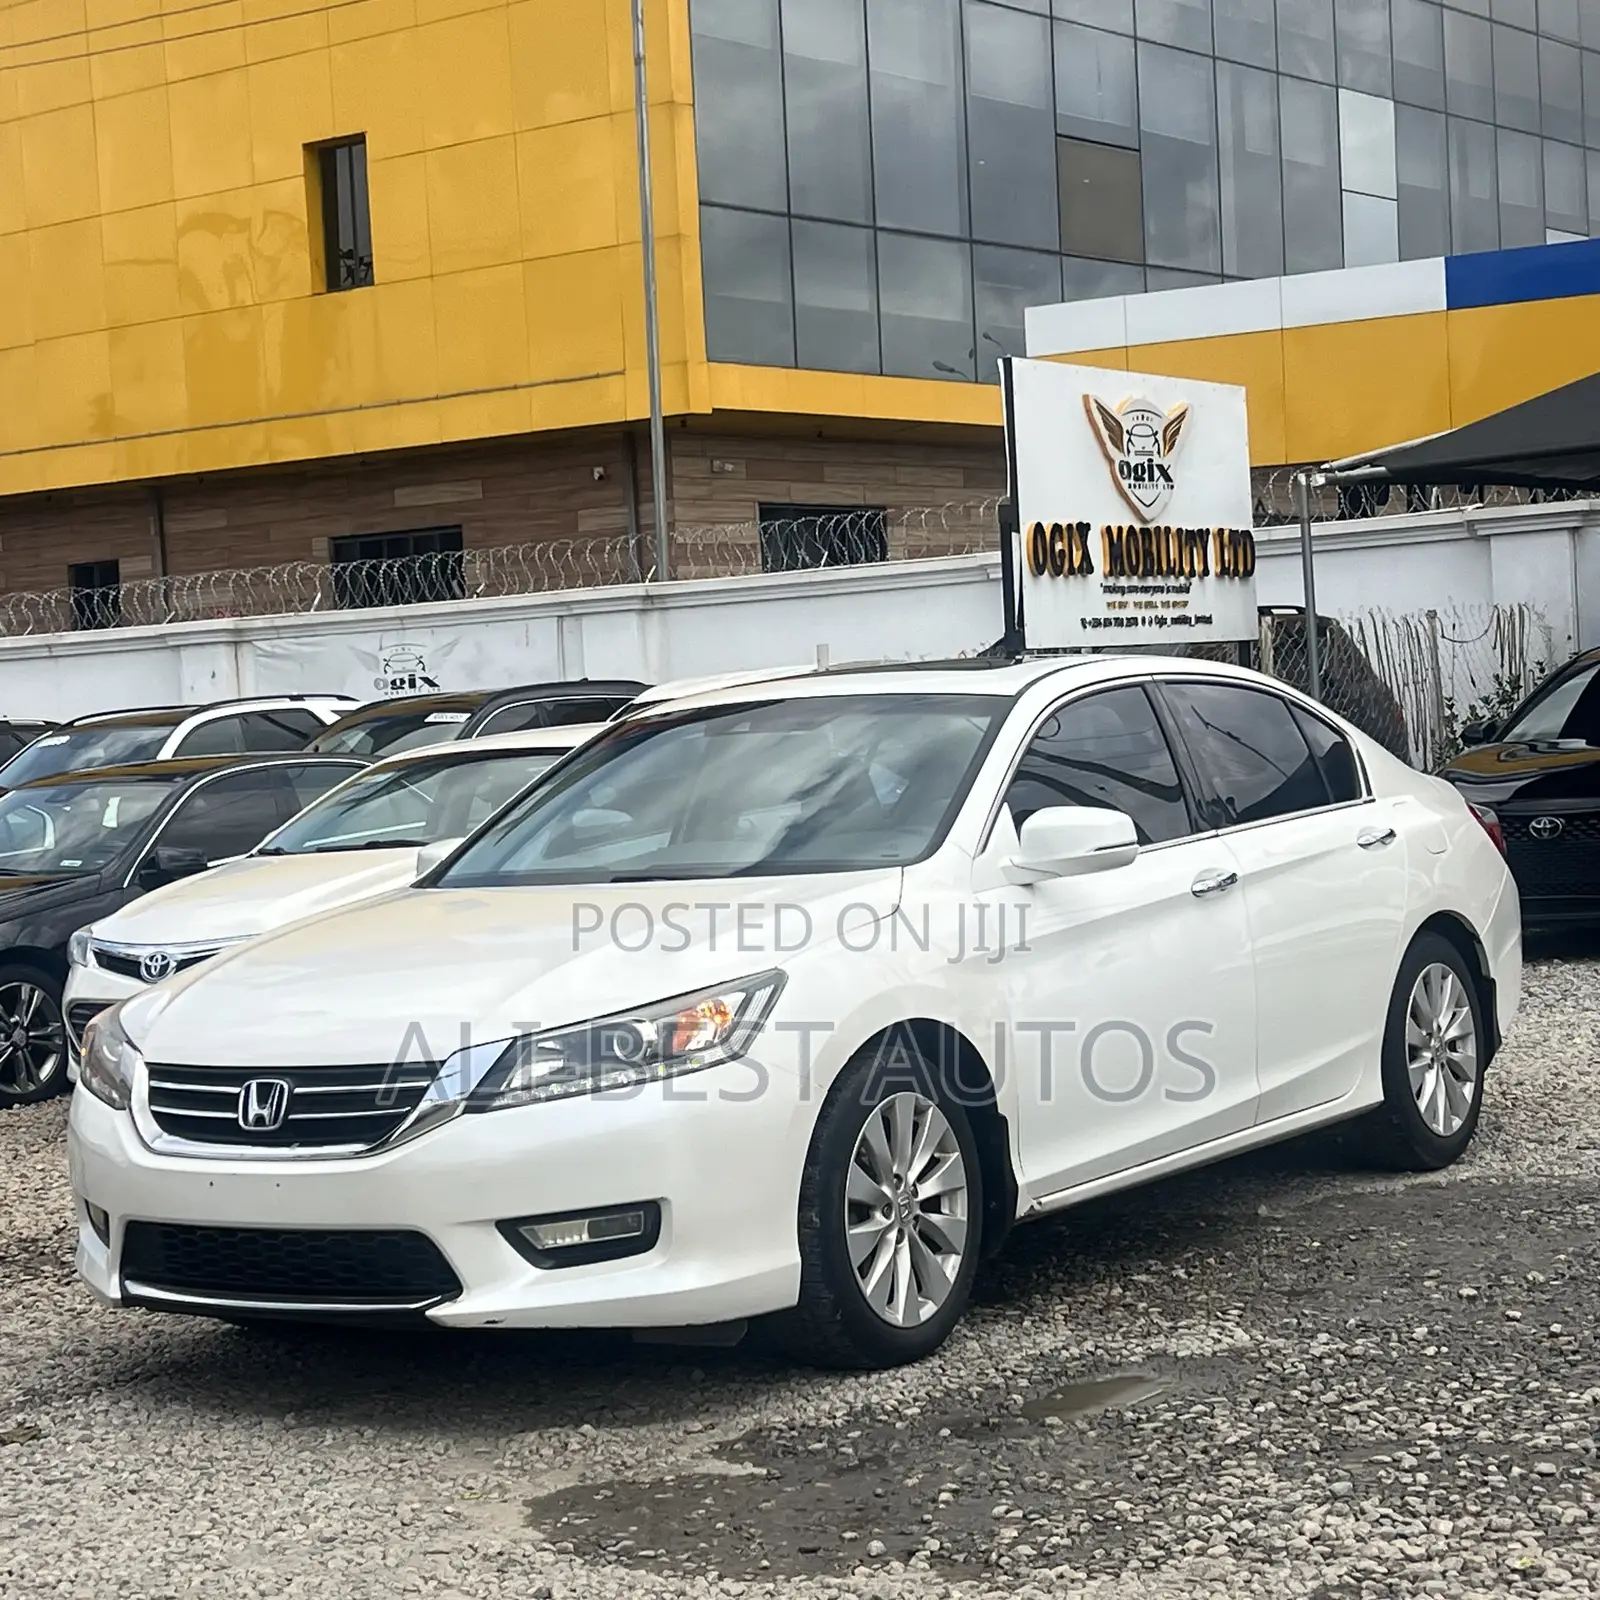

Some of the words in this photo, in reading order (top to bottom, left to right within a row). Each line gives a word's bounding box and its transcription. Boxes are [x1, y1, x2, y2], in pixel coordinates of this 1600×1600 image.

[1027, 521, 1095, 577] OGIX
[1101, 524, 1210, 578] MOBILITY
[1212, 528, 1256, 578] LTD
